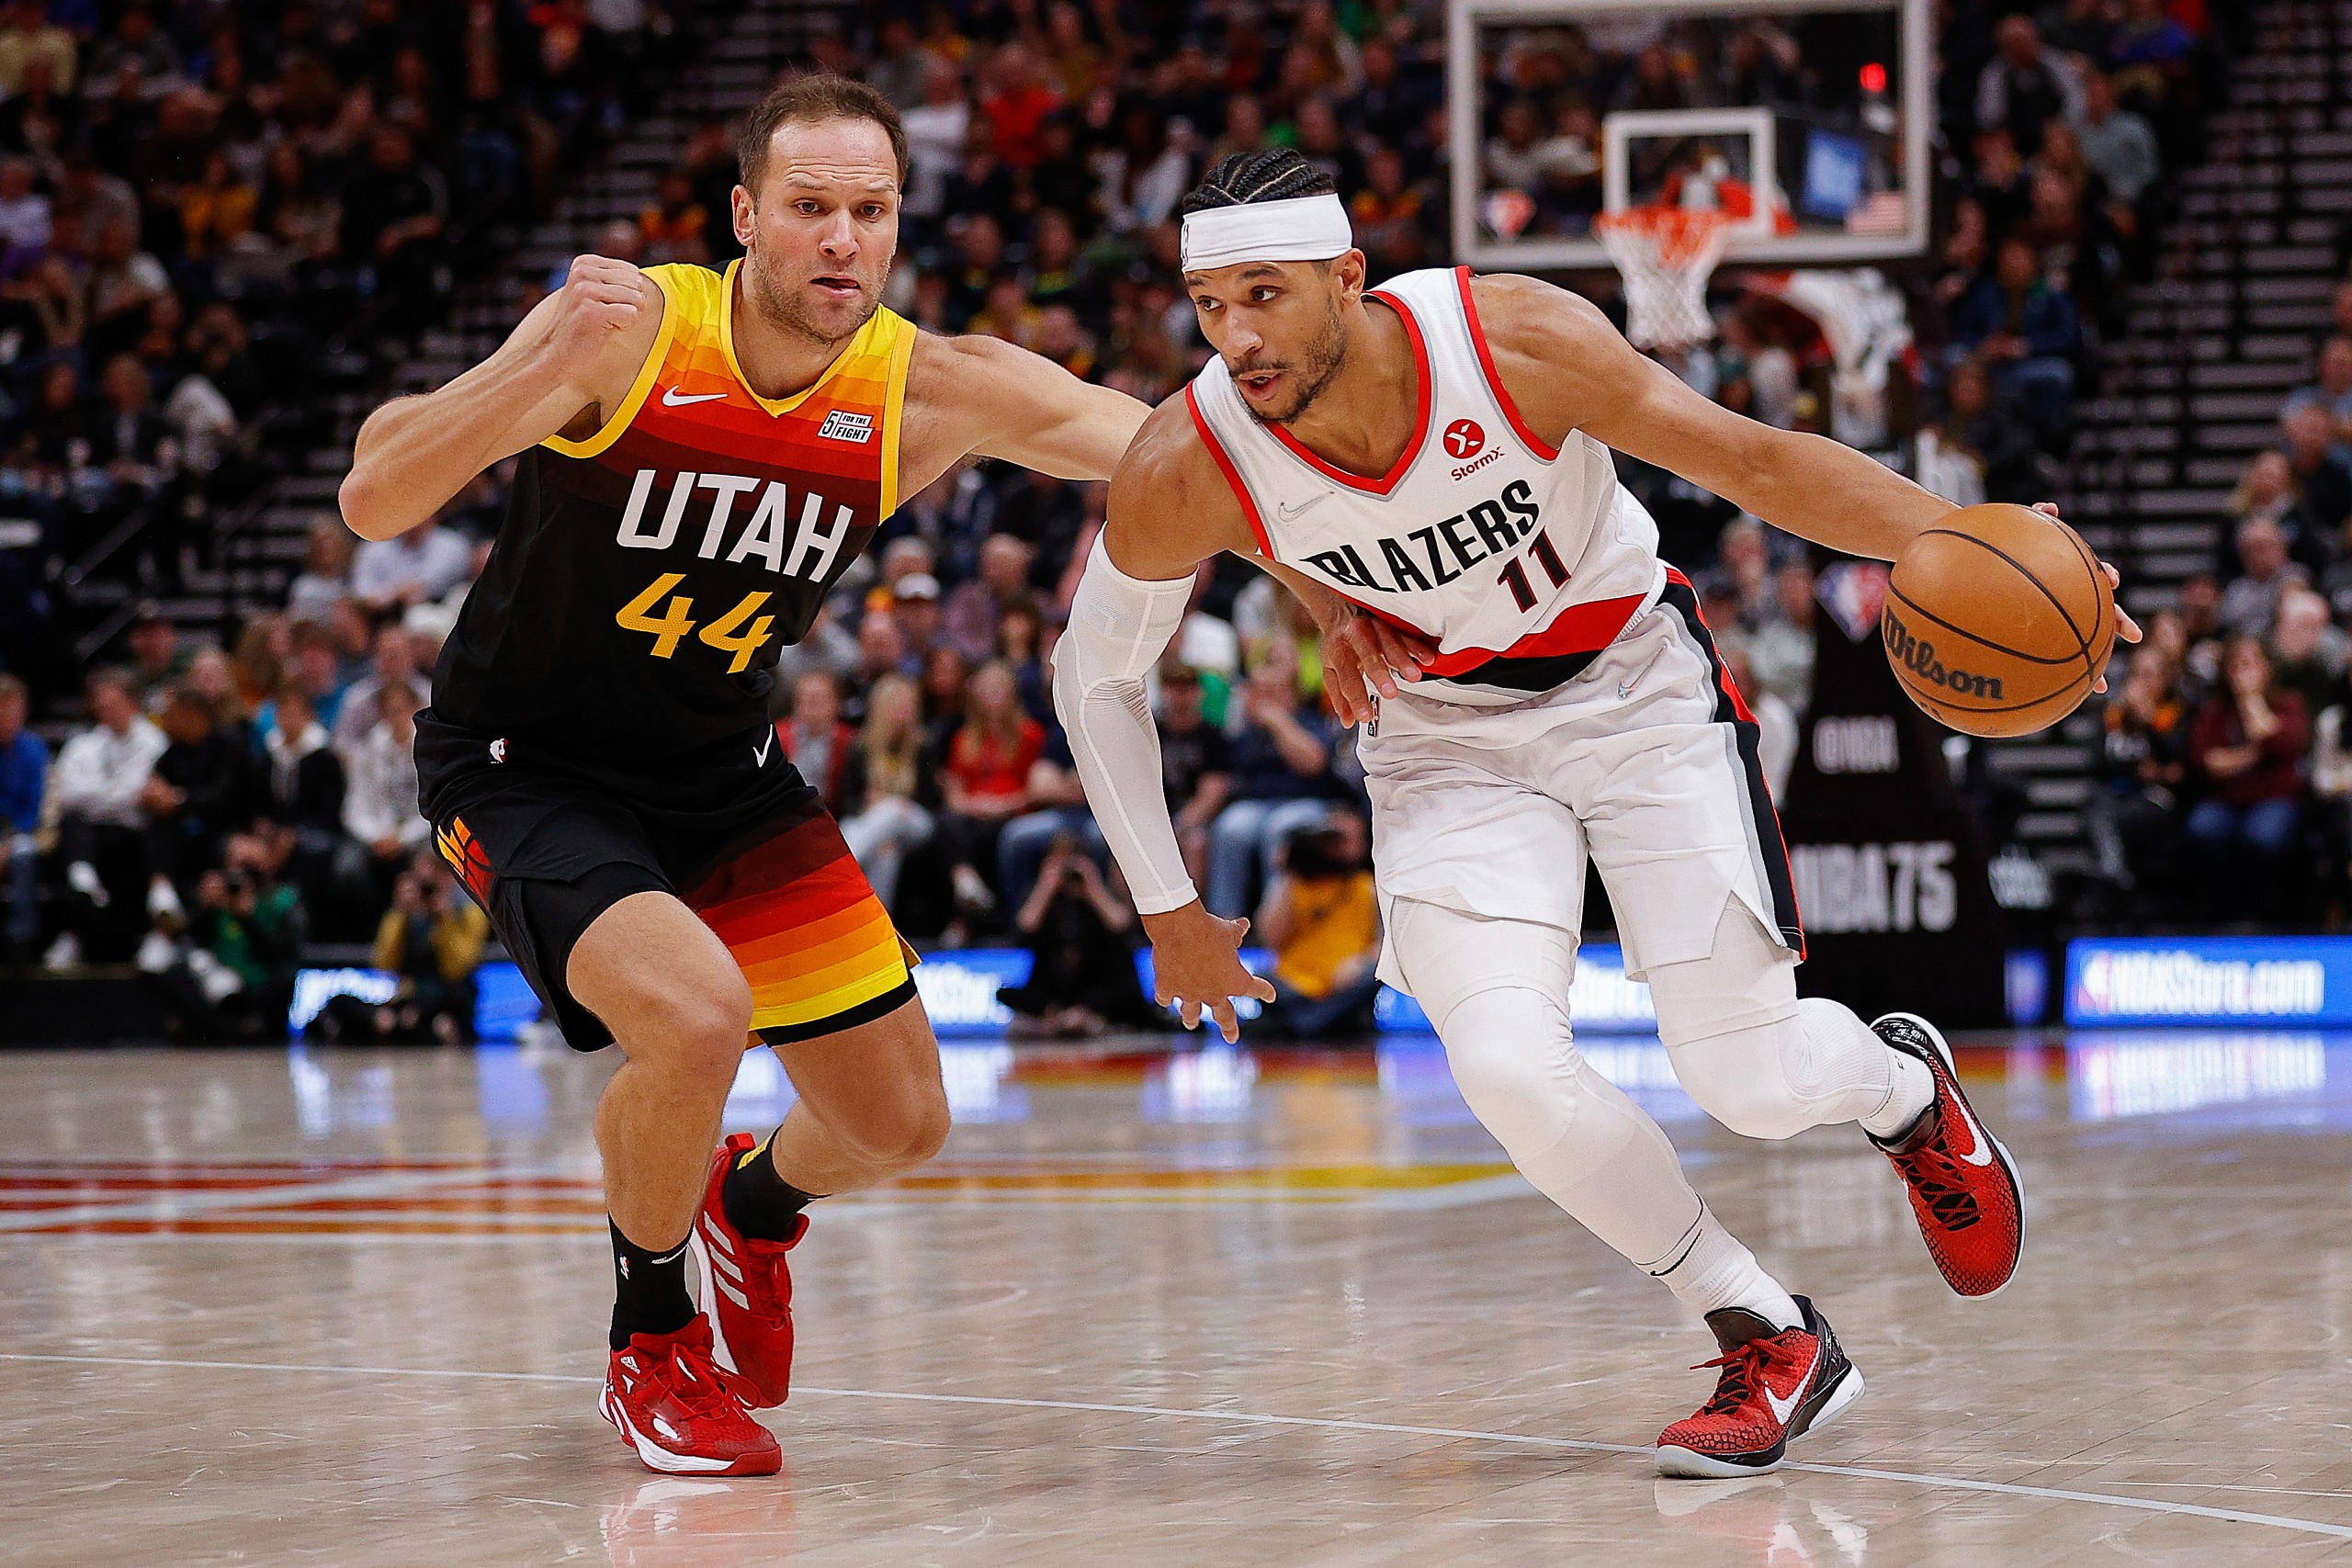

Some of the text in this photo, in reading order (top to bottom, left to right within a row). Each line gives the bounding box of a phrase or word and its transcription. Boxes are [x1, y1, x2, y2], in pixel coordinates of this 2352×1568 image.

[821, 412, 839, 435] 5
[835, 426, 869, 440] FIGHT
[842, 414, 868, 425] FOR THE
[616, 469, 854, 582] UTAH
[1298, 479, 1540, 593] BLAZERS
[1497, 525, 1572, 614] 11
[616, 572, 775, 674] 44
[1884, 604, 2005, 701] Wilson
